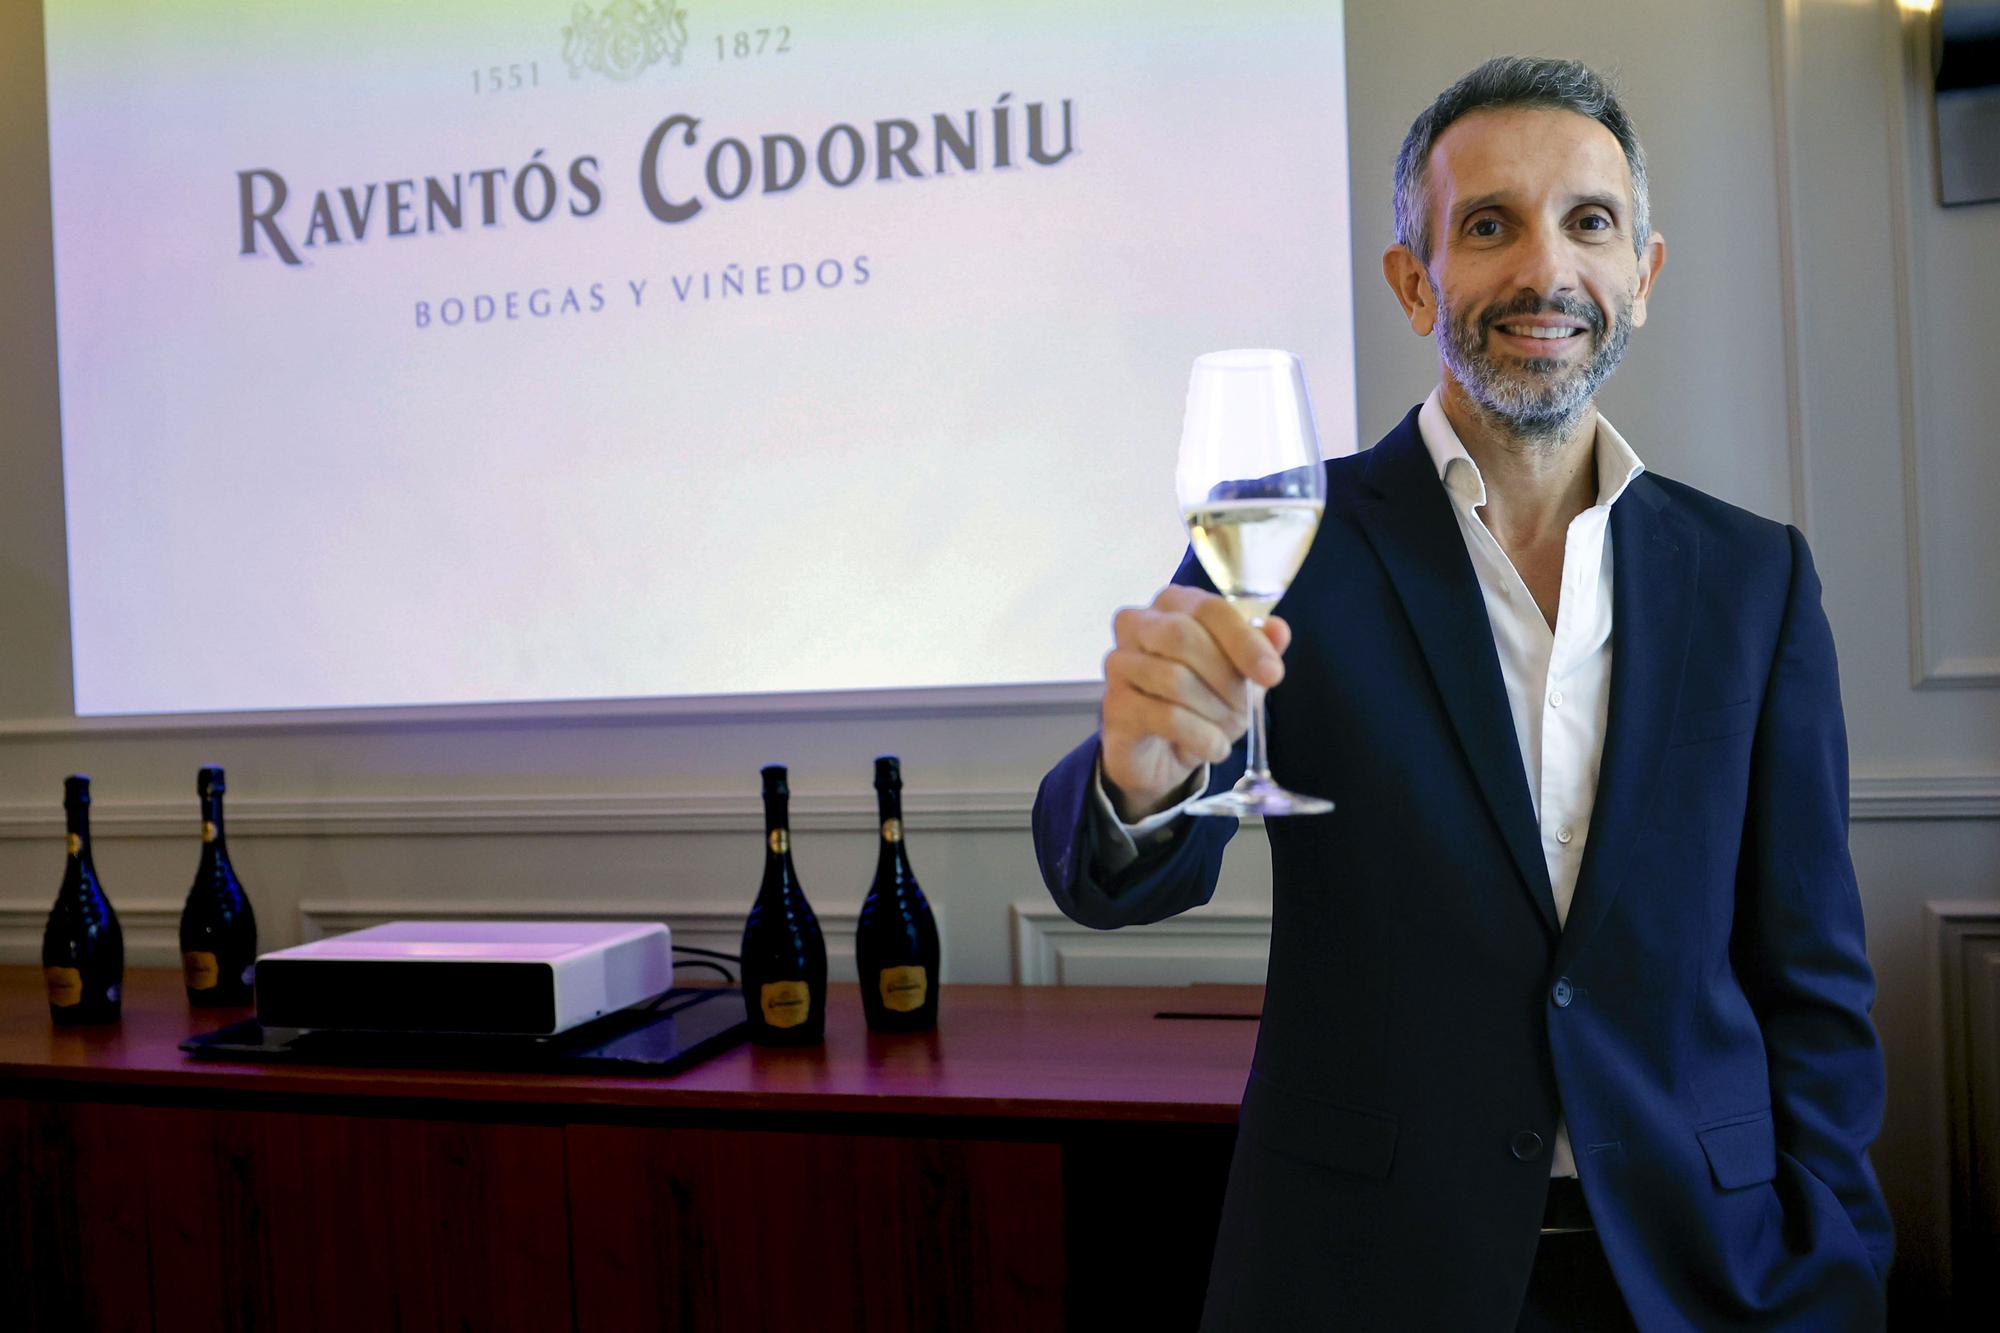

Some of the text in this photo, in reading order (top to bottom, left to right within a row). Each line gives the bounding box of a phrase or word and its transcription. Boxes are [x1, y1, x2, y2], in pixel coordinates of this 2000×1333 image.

[470, 25, 793, 95] 1551 1872
[236, 90, 1075, 267] RAVENTÓS CODORNÍU
[414, 254, 872, 329] BODEGAS Y VIÑEDOS
